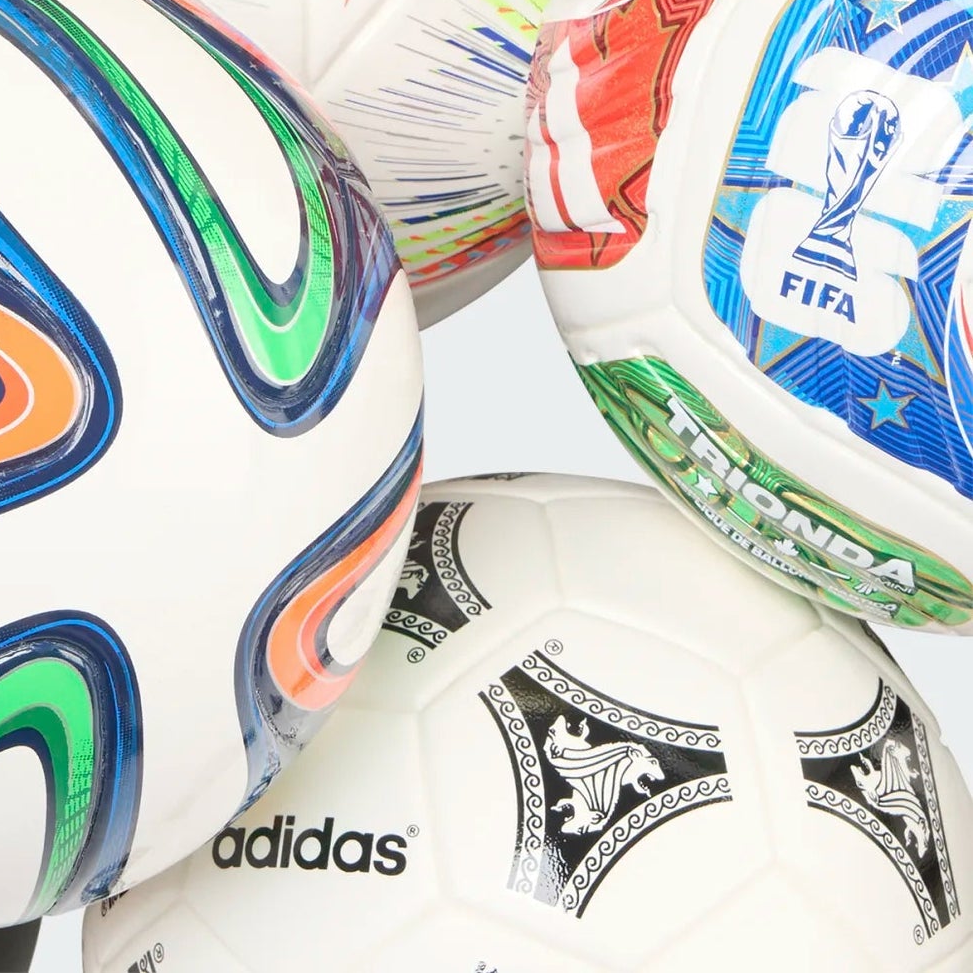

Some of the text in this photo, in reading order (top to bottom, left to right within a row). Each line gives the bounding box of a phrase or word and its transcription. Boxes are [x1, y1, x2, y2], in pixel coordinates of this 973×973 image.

[780, 271, 856, 324] FIFA
[667, 396, 915, 588] TRIONDA
[730, 530, 751, 550] DE
[750, 545, 808, 580] BALLO
[212, 815, 407, 876] adidas
